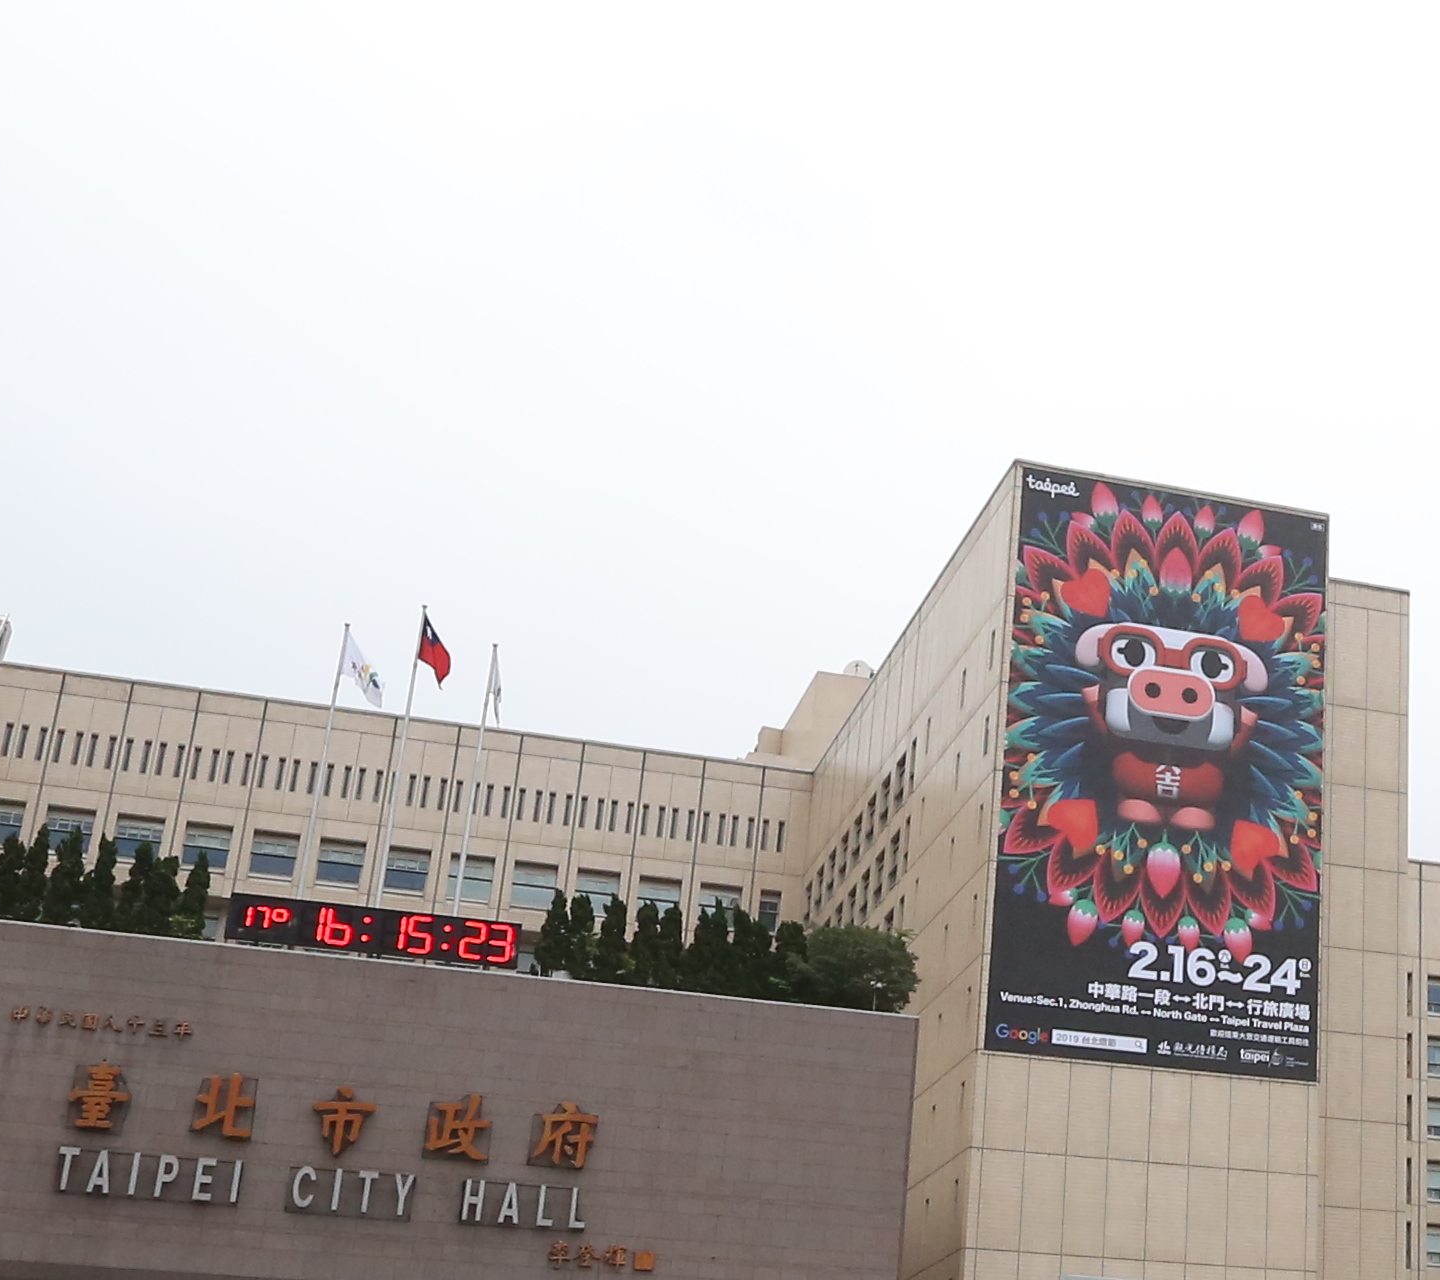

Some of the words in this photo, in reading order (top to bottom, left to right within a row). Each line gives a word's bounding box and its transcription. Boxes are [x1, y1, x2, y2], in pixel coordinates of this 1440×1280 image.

[1069, 999, 1120, 1013] Zhonghua
[1122, 1005, 1139, 1015] Rd.
[1153, 1008, 1182, 1019] North
[1184, 1011, 1207, 1022] Gate
[1221, 1015, 1250, 1027] Taipei
[1252, 1019, 1282, 1030] Travel
[1284, 1022, 1309, 1033] Plaza
[1087, 981, 1171, 1006] 中華路一段
[1192, 993, 1225, 1011] 北門
[1247, 999, 1310, 1020] 行旅廣場
[996, 1024, 1049, 1045] Google
[69, 1060, 600, 1168] 臺北市政府
[59, 1147, 243, 1202] TAIPEI
[292, 1166, 417, 1216] CITY
[460, 1178, 586, 1229] HALL
